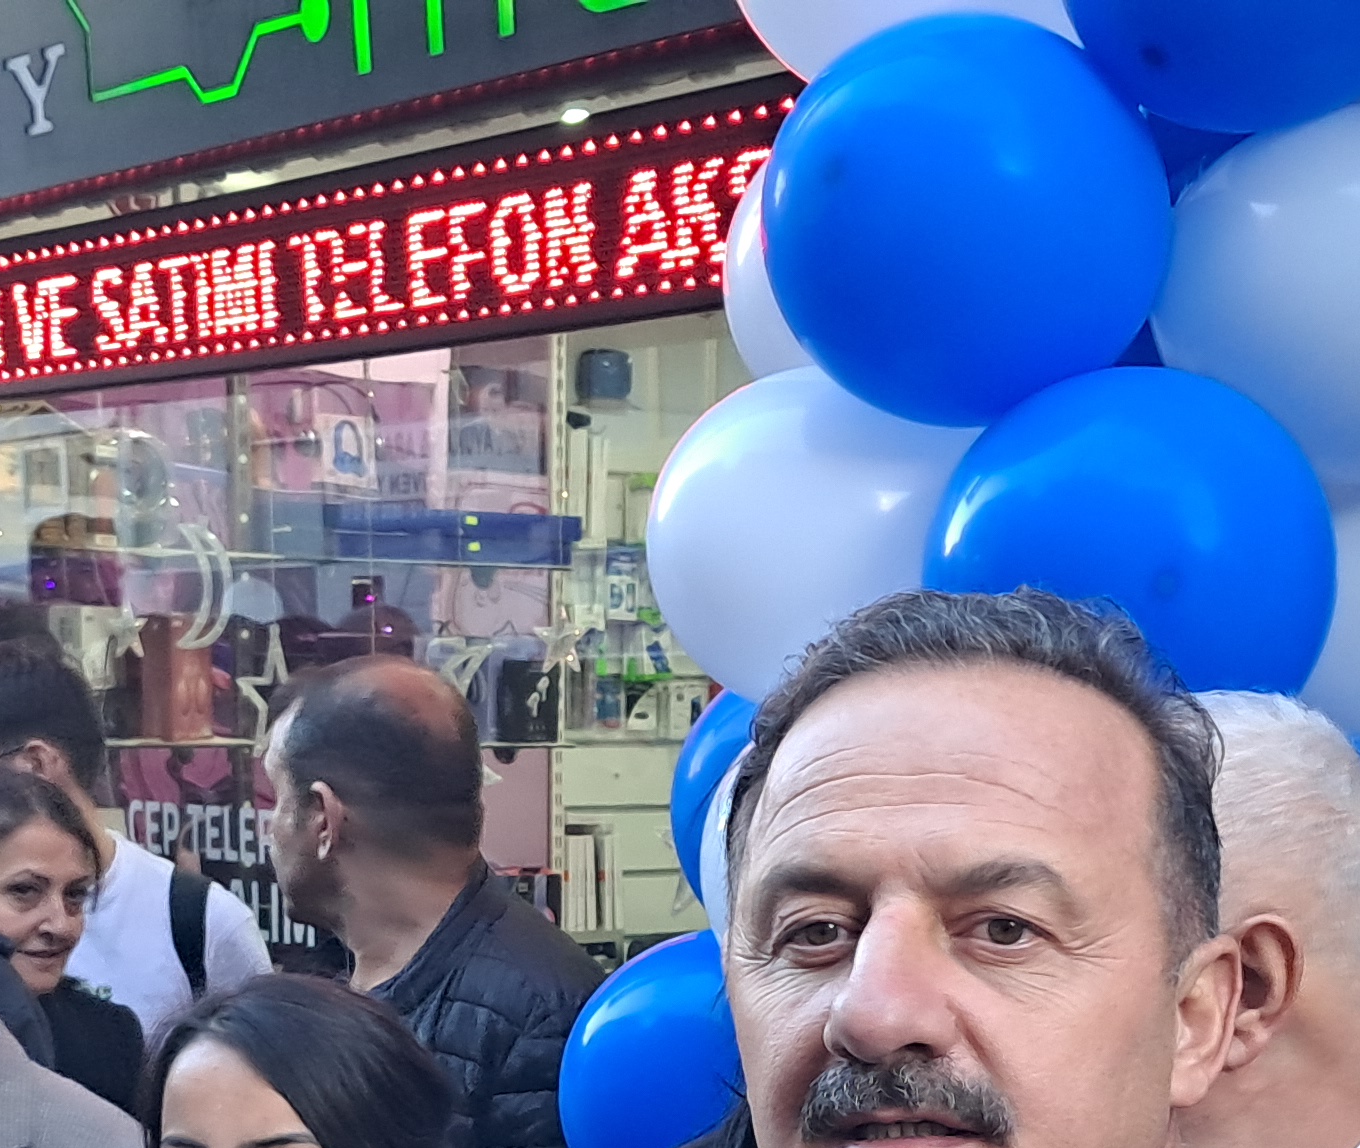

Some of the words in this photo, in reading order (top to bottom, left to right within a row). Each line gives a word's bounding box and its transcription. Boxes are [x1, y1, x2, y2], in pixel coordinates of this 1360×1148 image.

[12, 273, 80, 362] VE
[91, 239, 280, 352] SATIMI
[287, 181, 599, 324] TELEFON
[127, 799, 180, 856] CEP
